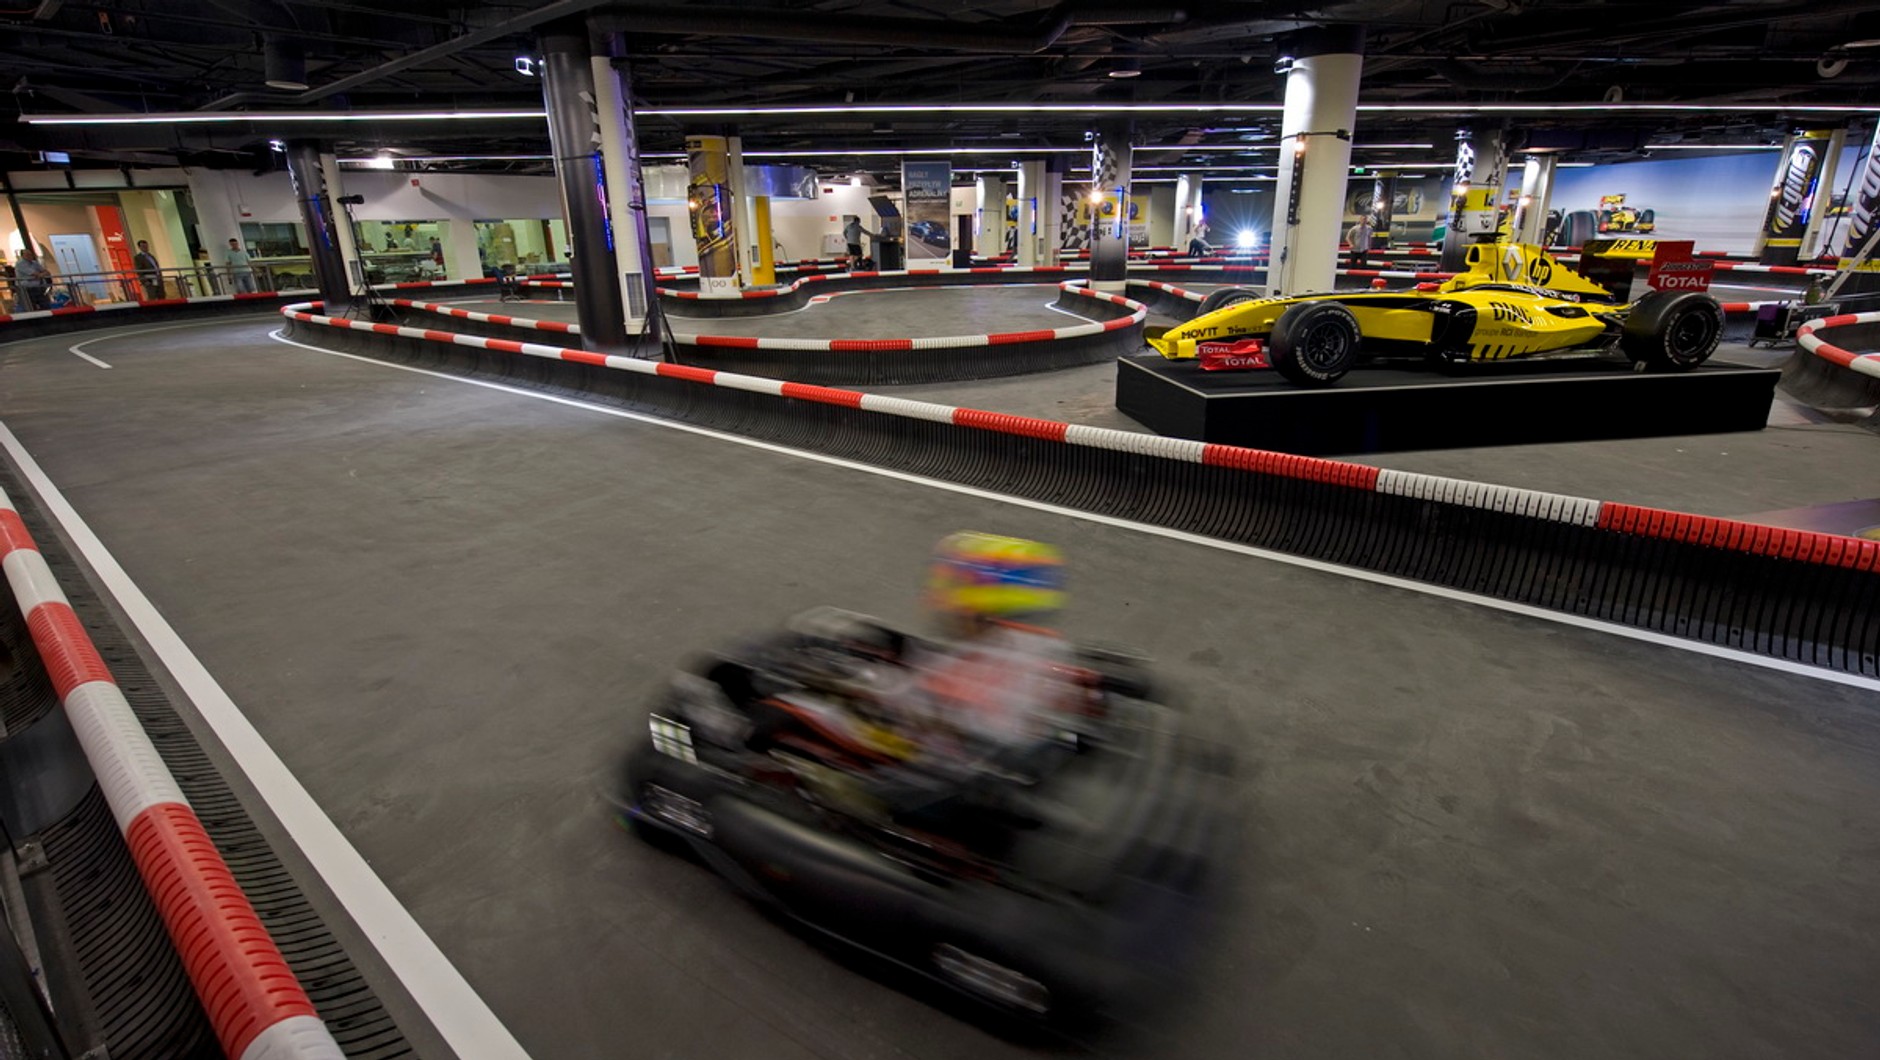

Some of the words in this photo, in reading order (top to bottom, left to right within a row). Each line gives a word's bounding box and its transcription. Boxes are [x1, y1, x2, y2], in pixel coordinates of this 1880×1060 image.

[1612, 239, 1657, 250] RENA
[1657, 274, 1710, 288] TOTAL
[1180, 327, 1218, 340] MOVIT
[1202, 345, 1231, 354] TOTAL
[1224, 356, 1264, 367] TOTAL
